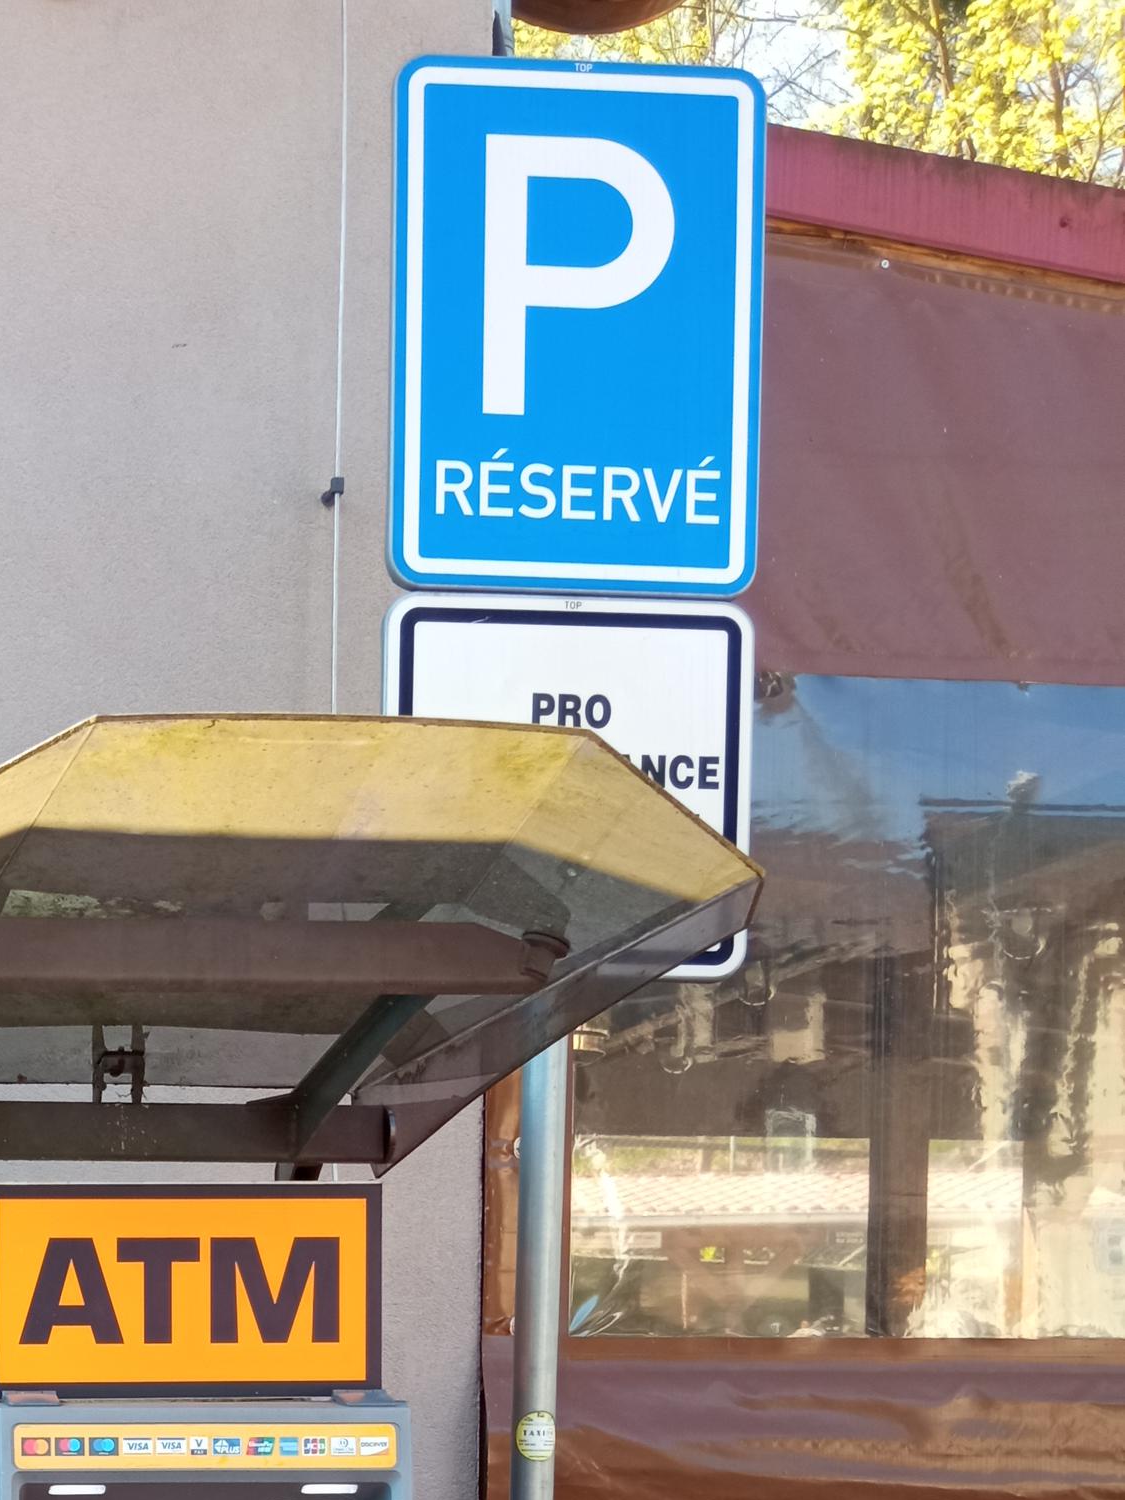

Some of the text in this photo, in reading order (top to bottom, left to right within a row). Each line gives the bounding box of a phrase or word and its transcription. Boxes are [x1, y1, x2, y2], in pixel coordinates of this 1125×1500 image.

[575, 63, 593, 72] TOP
[482, 133, 675, 415] P
[434, 448, 721, 525] RÉSERVÉ
[564, 601, 582, 610] TOP
[531, 692, 612, 729] PRO
[18, 1236, 341, 1345] ATM
[127, 1442, 149, 1450] VISA
[161, 1442, 182, 1450] VISA
